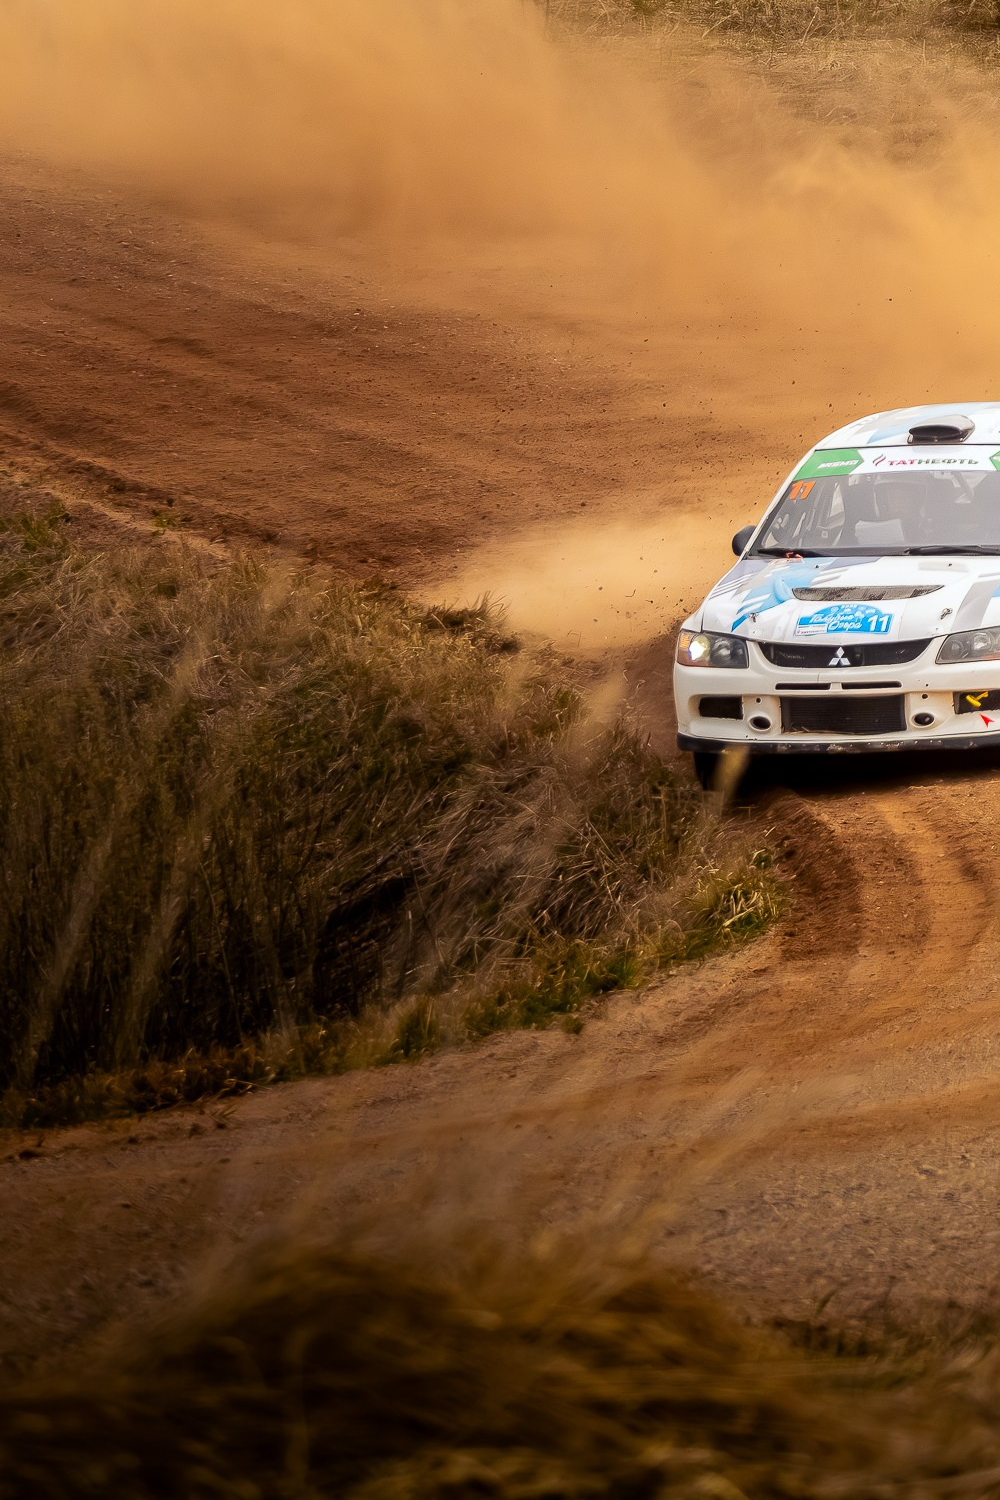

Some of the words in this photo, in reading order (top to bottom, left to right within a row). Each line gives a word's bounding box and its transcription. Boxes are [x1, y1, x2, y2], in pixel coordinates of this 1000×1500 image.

[888, 458, 978, 466] ТАТНЕФТЬ
[789, 480, 816, 500] 11
[868, 614, 889, 632] 11
